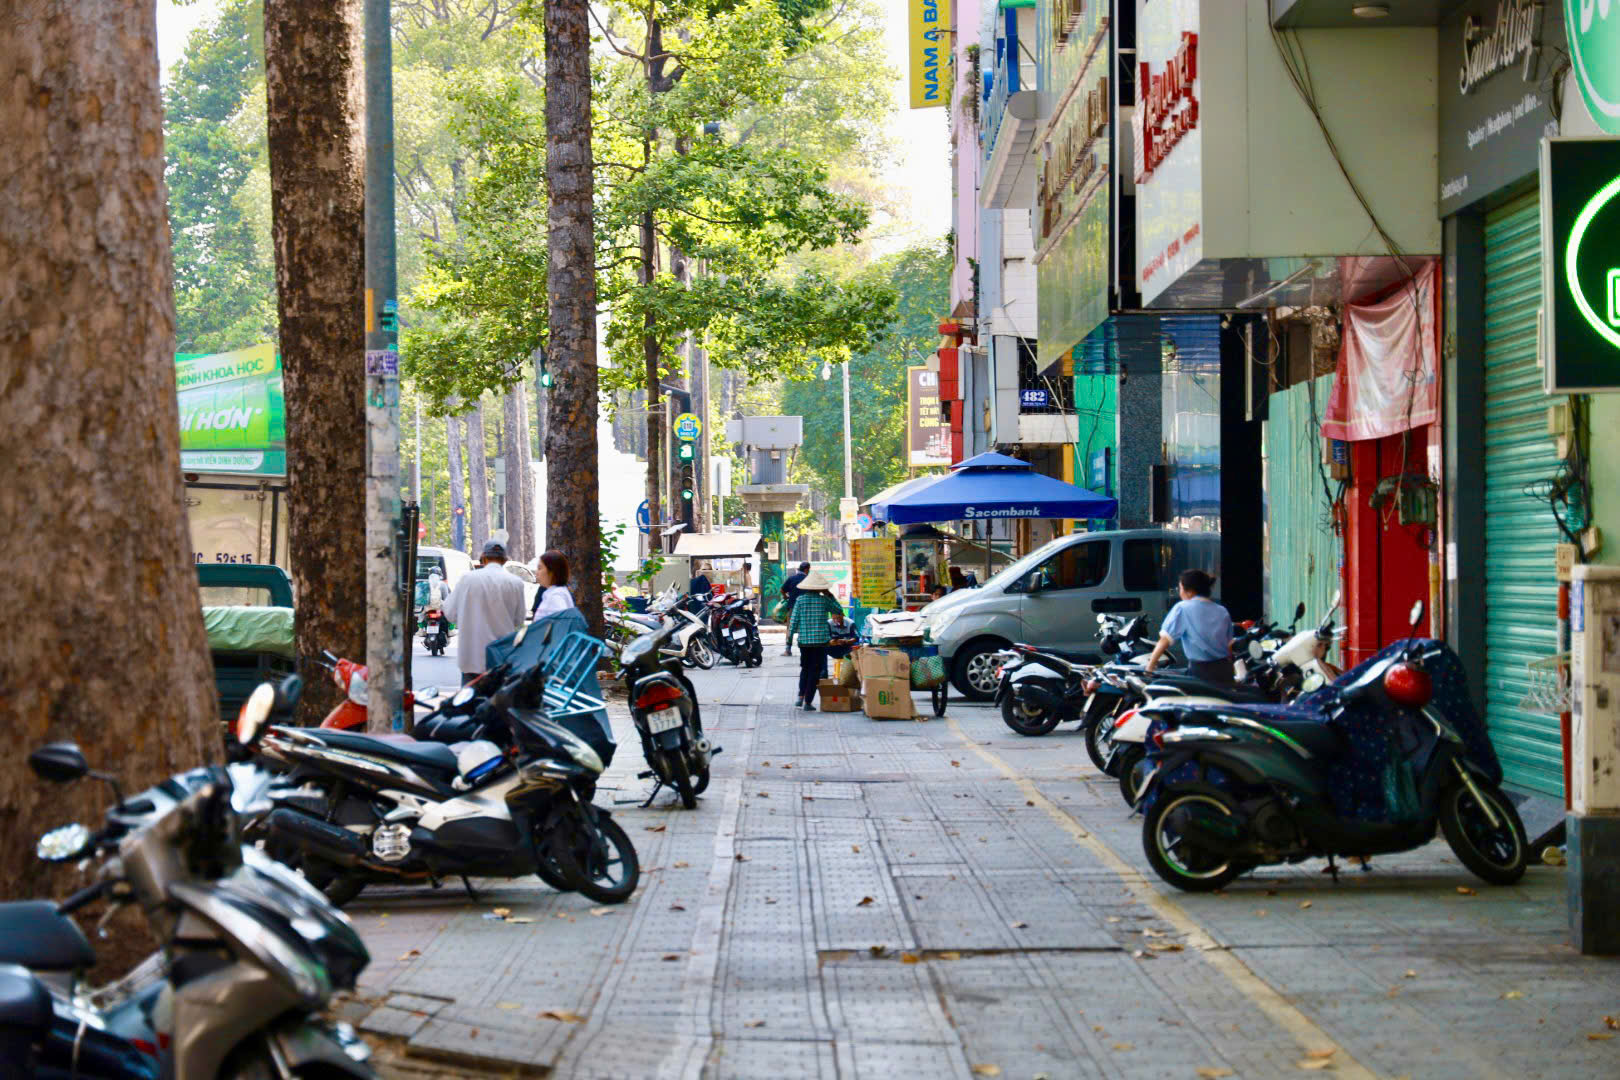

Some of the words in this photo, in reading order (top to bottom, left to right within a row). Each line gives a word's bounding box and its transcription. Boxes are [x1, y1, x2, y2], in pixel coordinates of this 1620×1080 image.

[924, 47, 938, 100] NAM
[203, 366, 234, 382] KHOA
[237, 358, 264, 376] HỌC
[1024, 391, 1045, 401] 482
[196, 406, 254, 430] HƠN
[964, 506, 1040, 518] Sacombank
